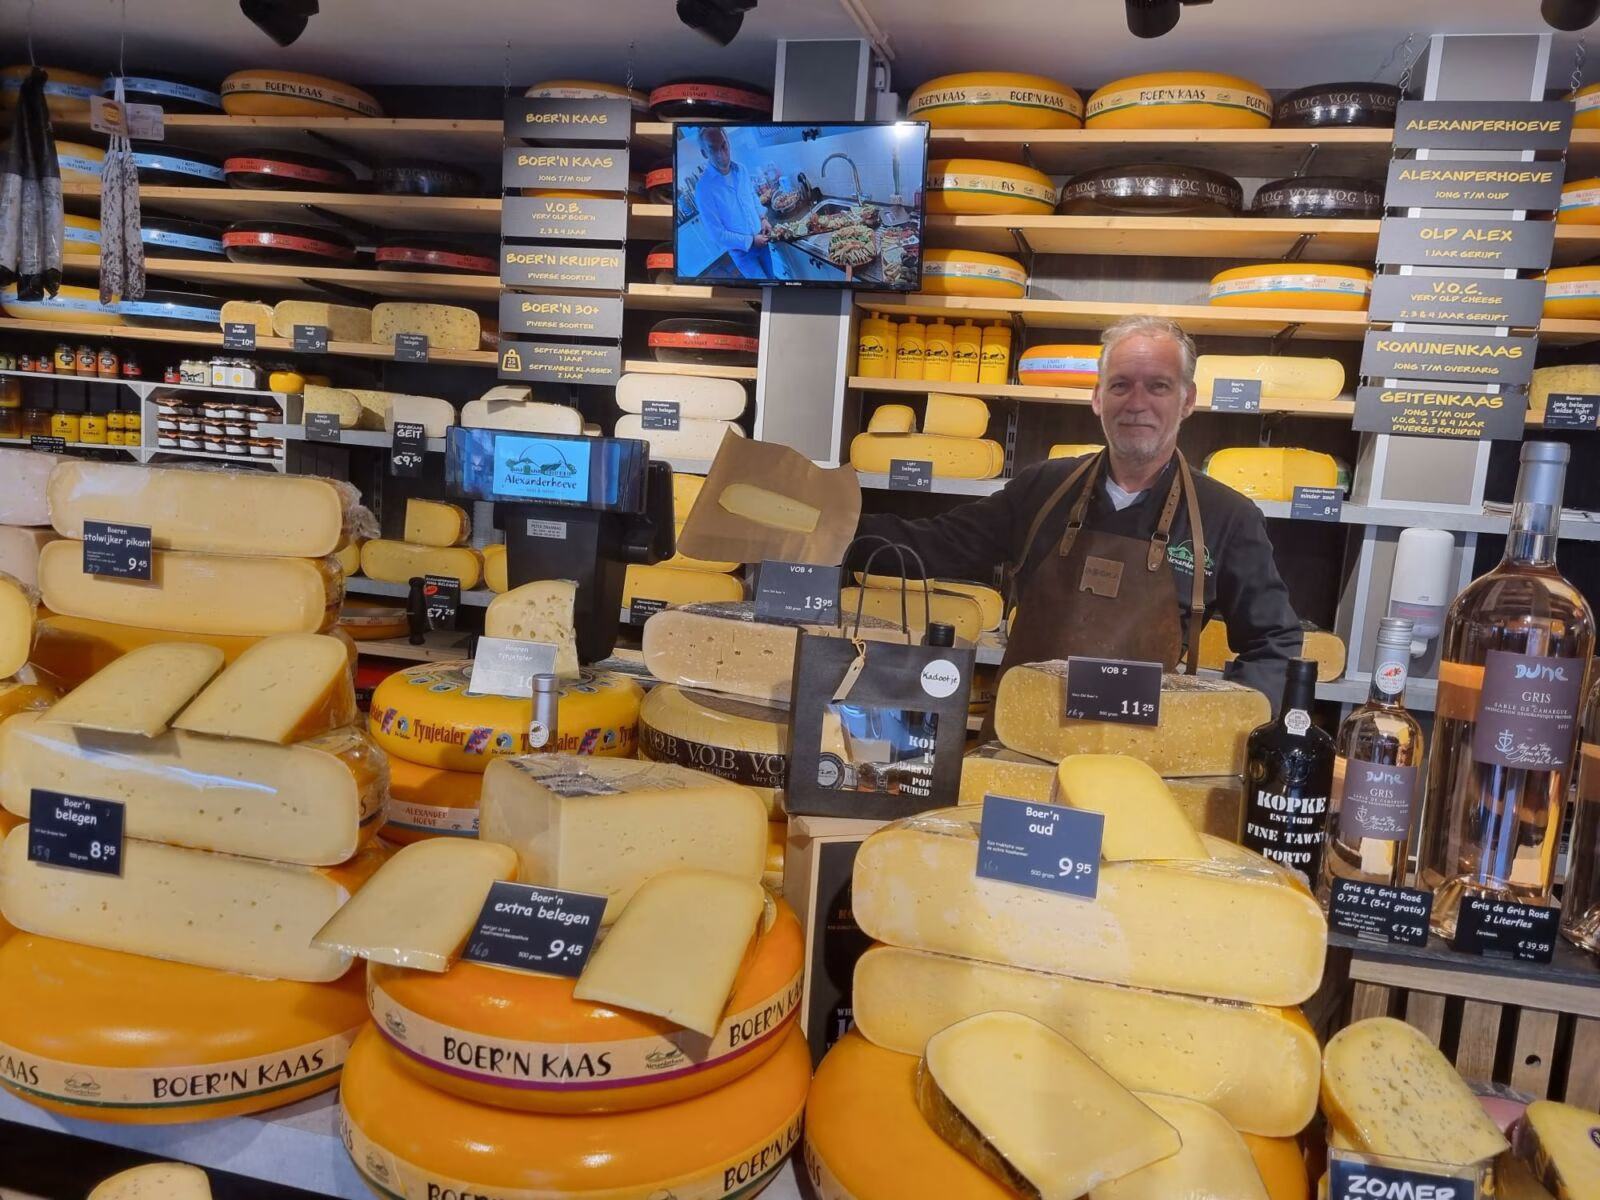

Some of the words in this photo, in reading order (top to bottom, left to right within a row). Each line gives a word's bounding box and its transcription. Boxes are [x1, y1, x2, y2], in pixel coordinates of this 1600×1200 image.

[299, 86, 322, 98] KAAS
[942, 90, 966, 103] KAAS
[1140, 88, 1176, 100] BOER'N
[1178, 89, 1205, 99] KAAS
[1010, 90, 1041, 102] BOER'N
[1044, 95, 1064, 108] KAAS
[526, 113, 570, 124] BOER'N
[572, 114, 608, 124] KAAS
[1406, 119, 1561, 132] ALEXANDERHOEVE
[518, 155, 569, 167] BOER'N
[572, 157, 613, 168] KAAS
[1399, 170, 1552, 183] ALEXANDERHOEVE
[1435, 191, 1460, 199] JONG
[1463, 191, 1485, 199] T/M
[1487, 192, 1510, 200] OUD
[545, 202, 582, 213] V.O.B.
[1420, 228, 1458, 240] OLD
[1462, 229, 1513, 242] ALEX
[506, 253, 556, 265] BOER'N
[559, 255, 619, 268] KRUIDEN
[1460, 251, 1502, 259] GERIJPT
[528, 272, 560, 280] DIVERSE
[1432, 281, 1483, 295] V.O.C.
[1410, 295, 1437, 303] VERY
[1439, 295, 1460, 303] OLD
[1462, 296, 1503, 305] CHEESE
[521, 302, 571, 314] BOER'N
[575, 305, 600, 315] 30+
[1437, 312, 1465, 320] JAAR
[1466, 313, 1509, 322] GERIJPT
[526, 320, 558, 328] DIVERSE
[559, 322, 594, 330] SOORTEN
[534, 346, 581, 355] SEPTEMBER
[1376, 340, 1523, 359] KOMIJNENKAAS
[529, 363, 575, 372] SEPTEMBER
[1393, 362, 1418, 370] JONG
[1421, 363, 1442, 371] T/M
[1444, 364, 1499, 374] OVERJARIG
[1380, 391, 1504, 409] GEITENKAAS
[1403, 408, 1428, 417] JONG
[1431, 409, 1453, 418] T/M
[1455, 411, 1475, 419] OUD
[1392, 416, 1420, 425] V.O.G.
[1458, 420, 1485, 428] JAAR
[397, 429, 423, 439] GEIT
[1393, 425, 1435, 434] DIVERSE
[1437, 427, 1481, 436] KRUIDEN
[504, 474, 577, 489] Alexanderhoeve
[107, 526, 128, 535] Boeren
[84, 533, 123, 546] stolwijker
[126, 538, 151, 548] pikant
[790, 565, 805, 574] VOB
[1101, 665, 1119, 675] VOB
[1122, 667, 1128, 675] 2
[922, 672, 958, 685] Kadootje
[1522, 691, 1551, 704] GRIS
[413, 719, 467, 746] Tynjetaler
[686, 742, 740, 771] V.O.B.
[1370, 788, 1394, 798] GRIS
[64, 797, 91, 810] Boer'n
[1257, 790, 1327, 814] KOPKE
[56, 808, 97, 825] belegen
[1026, 806, 1060, 821] Boer'n
[1270, 813, 1289, 823] EST.
[1029, 823, 1054, 836] oud
[1247, 823, 1278, 841] FINE
[1263, 847, 1312, 865] PORTO
[1059, 857, 1092, 880] 9.95
[531, 892, 563, 906] Boer'n
[1343, 883, 1361, 893] Gris
[1364, 886, 1375, 895] de
[1378, 888, 1397, 899] Gris
[1400, 892, 1422, 903] Rosé
[1337, 893, 1359, 903] 0,75
[1361, 897, 1367, 905] L
[1370, 898, 1390, 908] (5+1
[1393, 904, 1426, 916] gratis)
[1471, 901, 1489, 911] Gris
[1493, 904, 1503, 912] de
[1507, 906, 1525, 916] Gris
[1529, 909, 1549, 919] Rosé
[494, 902, 532, 917] extra
[537, 906, 590, 926] belegen
[1484, 914, 1492, 922] 3
[1392, 924, 1399, 932] €
[547, 939, 583, 961] 9.45
[730, 1001, 785, 1048] BOER'N
[444, 1036, 531, 1077] BOER'N
[542, 1051, 611, 1079] KAAS
[153, 1068, 248, 1099] BOER'N
[259, 1049, 324, 1086] KAAS
[724, 1141, 783, 1192] BOER'N
[1348, 1175, 1456, 1200] ZOMER
